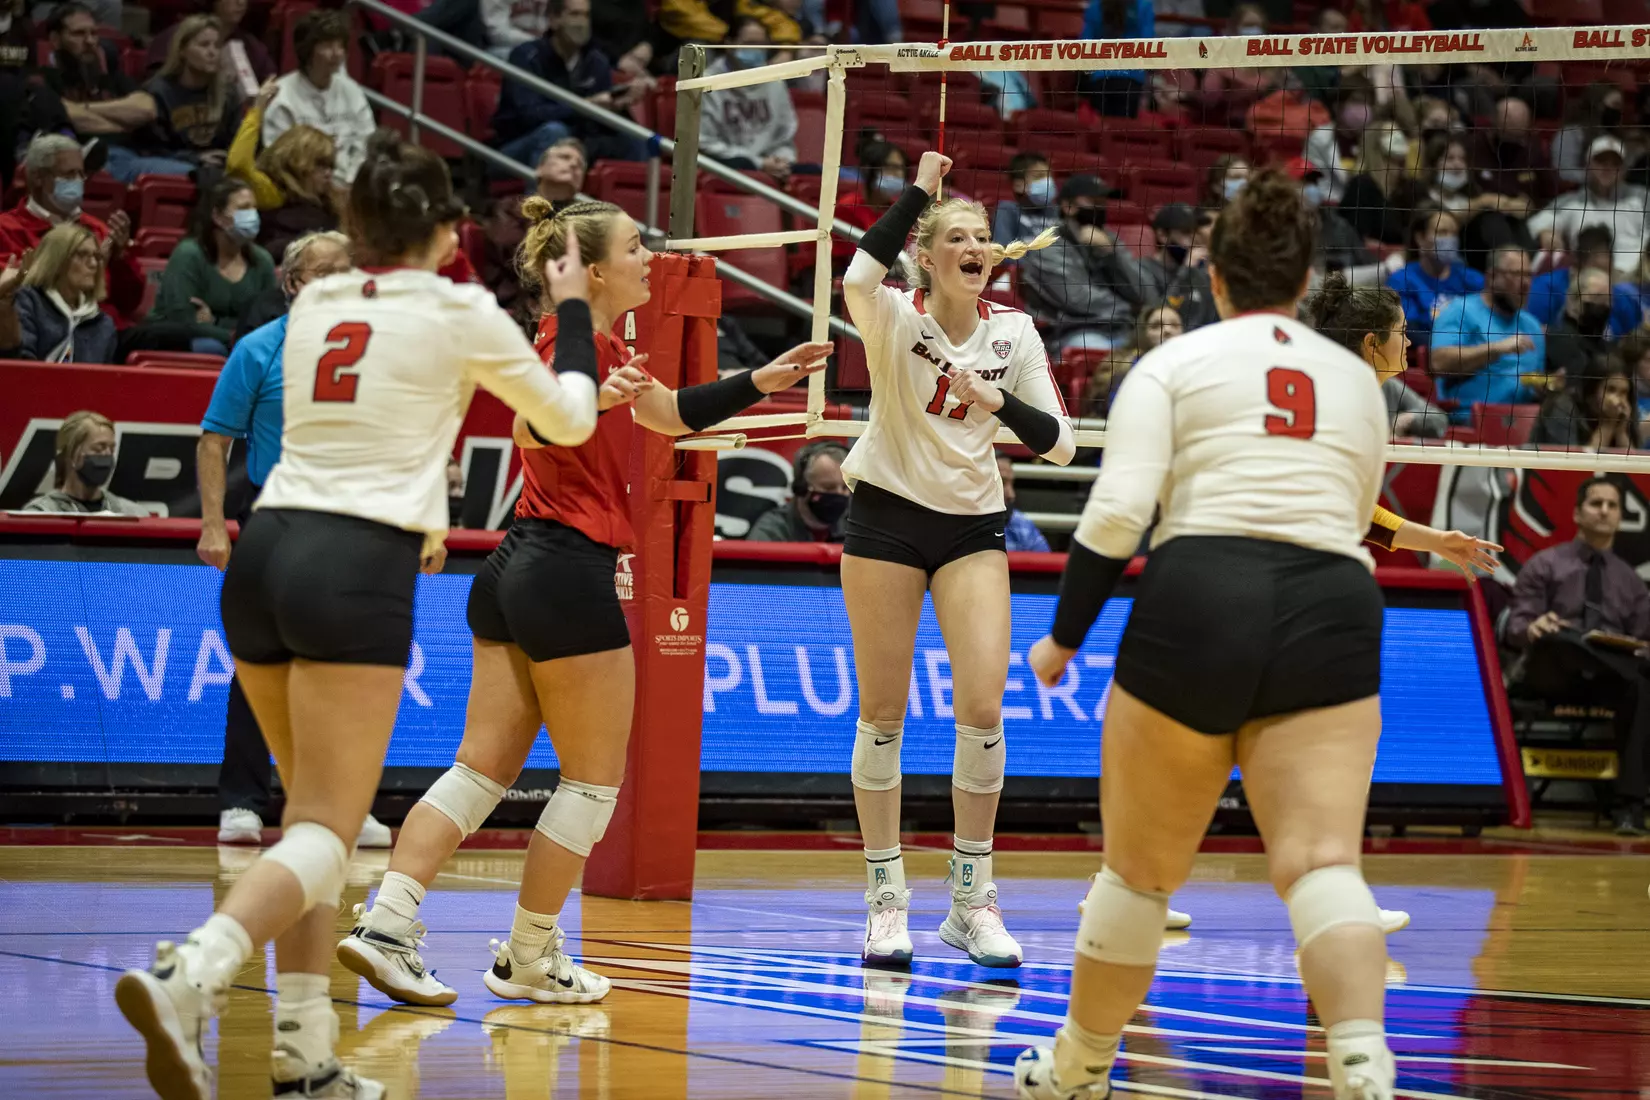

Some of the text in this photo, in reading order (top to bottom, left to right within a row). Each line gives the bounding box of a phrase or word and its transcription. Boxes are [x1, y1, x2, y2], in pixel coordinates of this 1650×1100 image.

[1246, 34, 1485, 56] BALL STATE VOLLEYBALL
[1573, 28, 1650, 49] BALL S
[950, 42, 1168, 61] BALL STATE VOLLEYBALL
[313, 321, 373, 402] 2
[1264, 366, 1316, 440] 9
